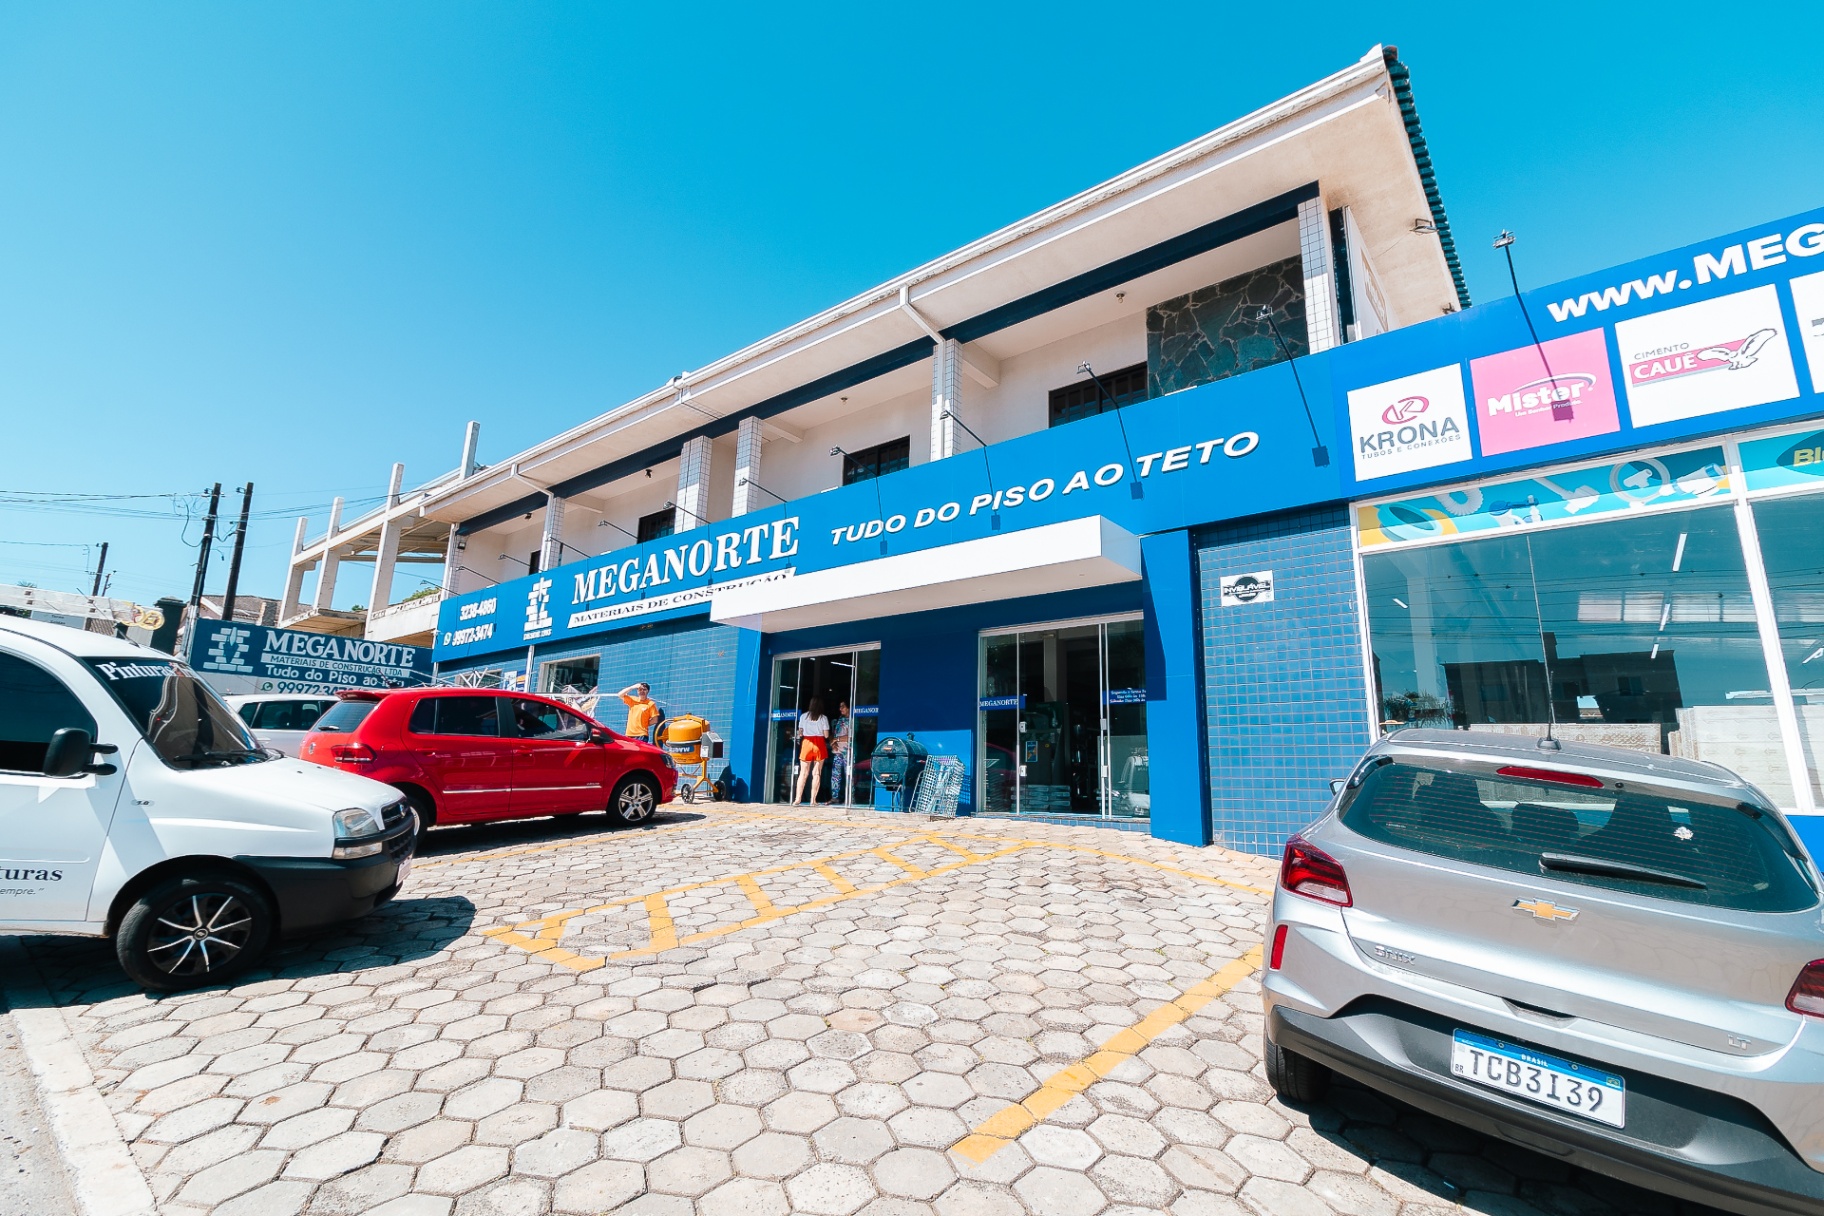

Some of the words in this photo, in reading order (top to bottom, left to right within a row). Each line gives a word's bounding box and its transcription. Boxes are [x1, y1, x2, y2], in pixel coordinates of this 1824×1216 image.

[1634, 342, 1690, 361] CIMENTO
[1633, 353, 1698, 380] CAUÊ
[1487, 382, 1584, 417] Mister
[1359, 416, 1460, 454] KRONA
[1361, 448, 1392, 460] TUBOS
[830, 514, 907, 546] TUDO
[913, 501, 961, 529] DO
[969, 477, 1056, 516] PISO
[1061, 462, 1125, 496] AO
[1135, 431, 1260, 478] TETO
[572, 515, 801, 605] MEGANORTE
[574, 602, 644, 624] MATERIAIS
[647, 597, 669, 610] DE
[452, 622, 494, 647] 99972-3474
[262, 630, 416, 667] MEGANORTE
[265, 665, 300, 678] Tudo
[304, 669, 323, 681] do
[328, 671, 357, 684] Piso
[362, 676, 378, 686] ao
[270, 655, 318, 667] MATERIAIS
[319, 660, 332, 669] DE
[384, 668, 403, 676] LTDA
[1727, 1033, 1752, 1050] LT
[1454, 1062, 1464, 1074] BR
[1520, 1053, 1549, 1068] BRASIL
